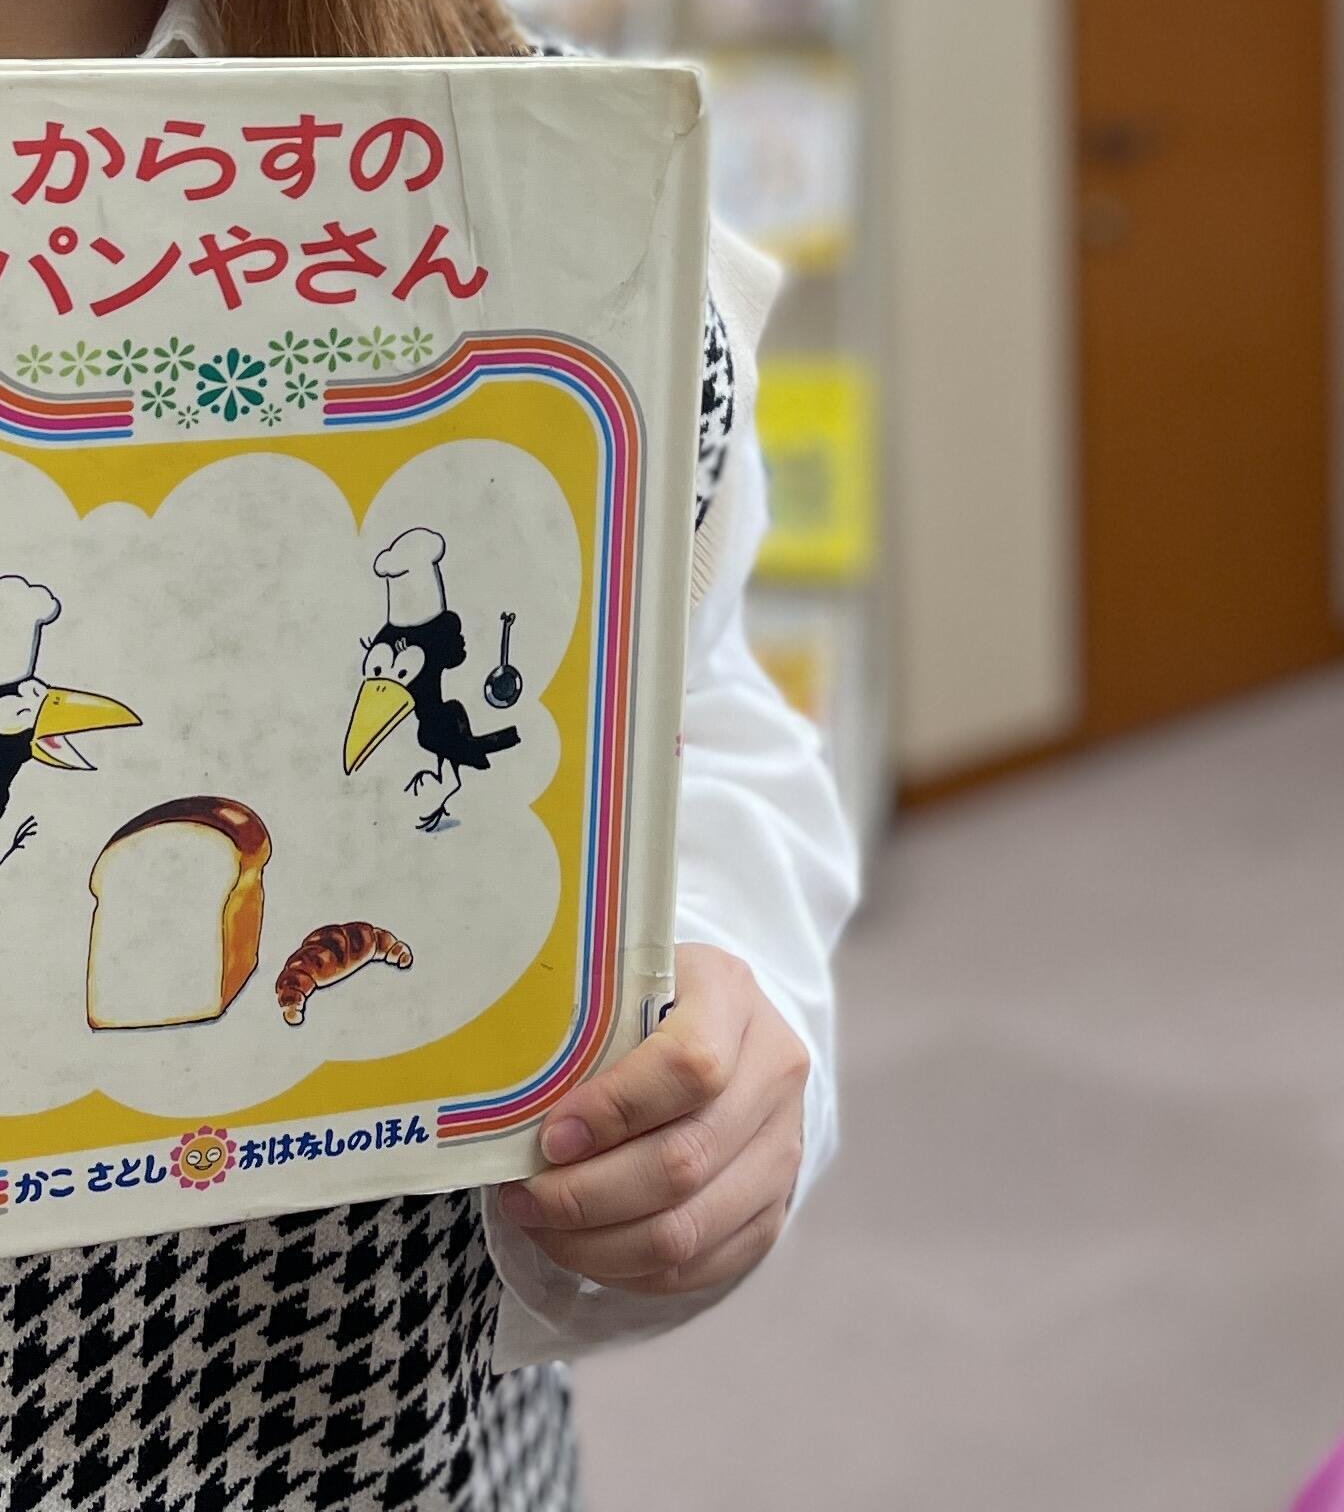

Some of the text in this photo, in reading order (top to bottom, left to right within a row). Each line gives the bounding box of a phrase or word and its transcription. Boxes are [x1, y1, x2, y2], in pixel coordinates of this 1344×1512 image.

[11, 113, 446, 206] からすの
[237, 1113, 431, 1172] おはなしのほん
[14, 1153, 169, 1205] かこ さとし
